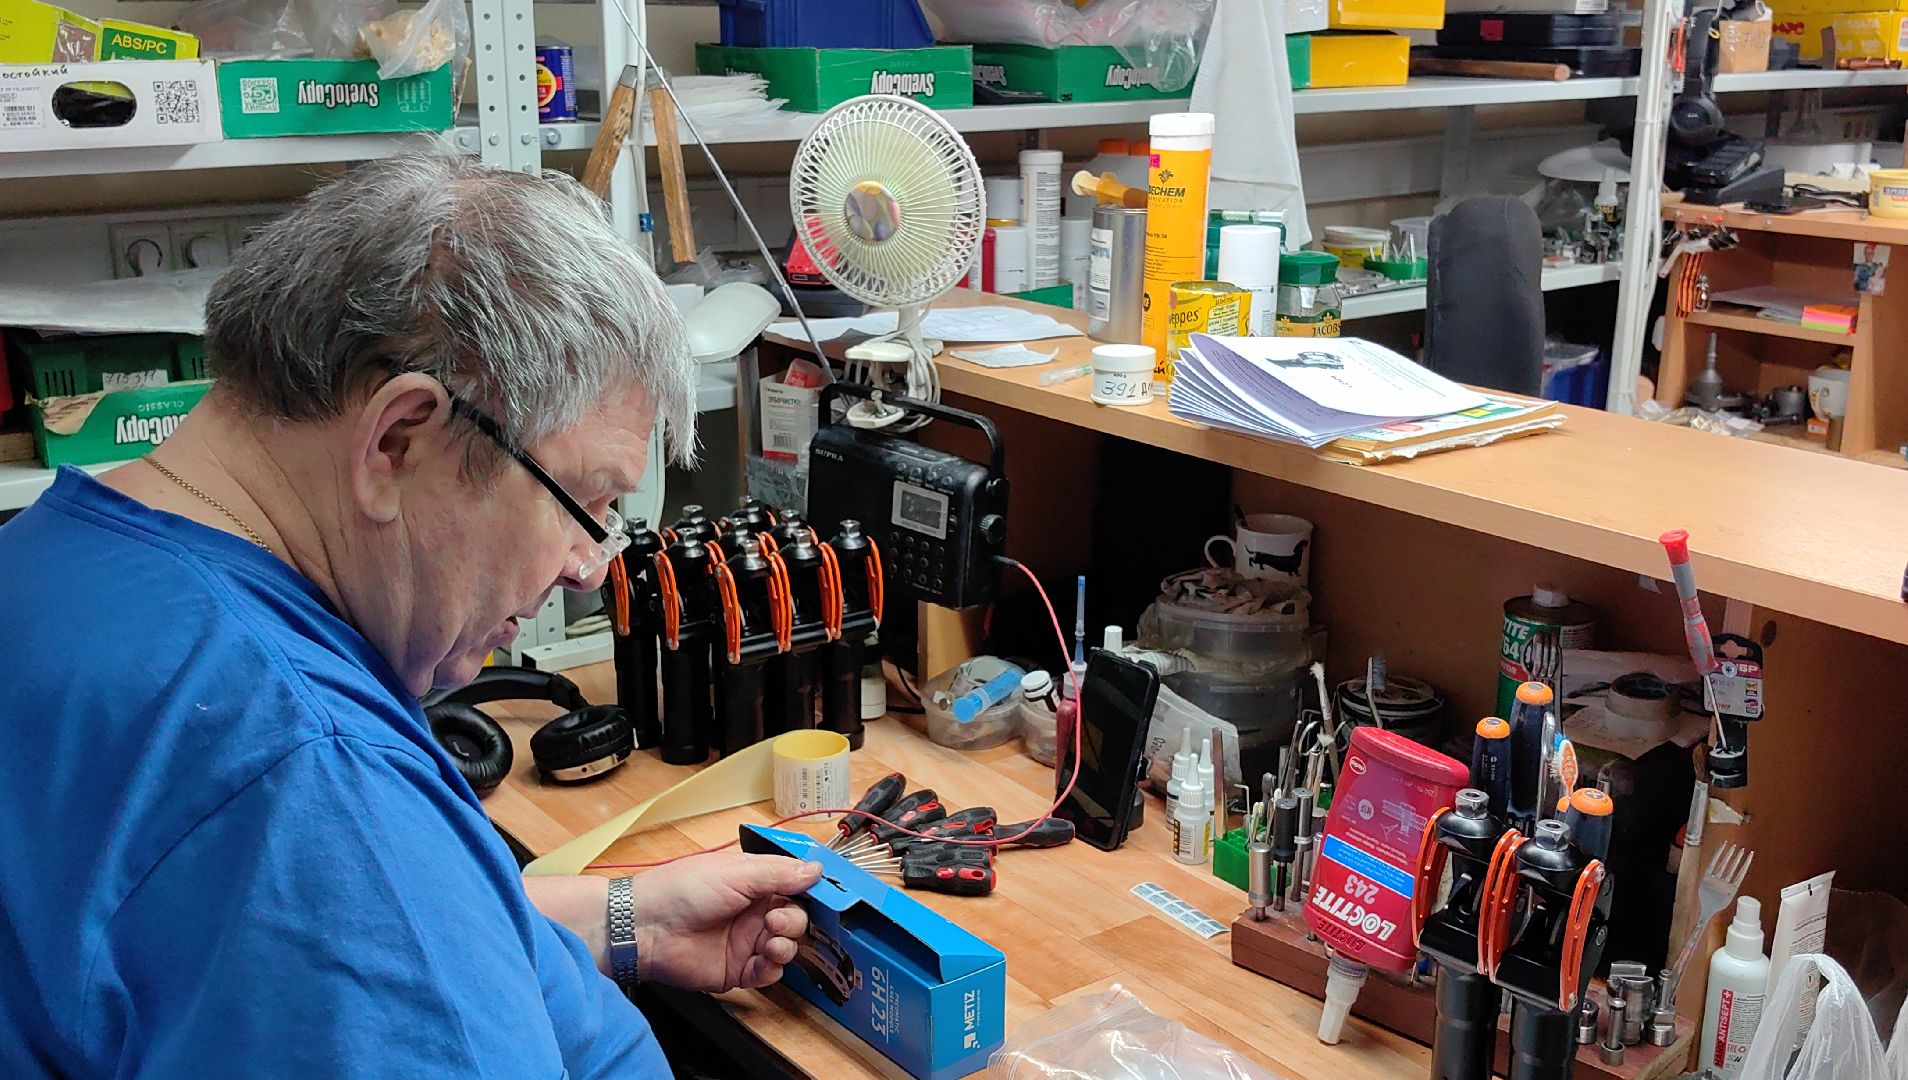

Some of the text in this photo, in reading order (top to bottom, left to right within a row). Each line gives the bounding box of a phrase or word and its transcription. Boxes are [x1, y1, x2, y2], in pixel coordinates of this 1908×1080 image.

[111, 34, 167, 54] ABS/PC
[297, 79, 379, 109] SvetoCopy
[870, 70, 935, 96] SvetoCopy
[1312, 321, 1342, 338] JACOBS
[138, 400, 185, 412] CLASSIC
[815, 448, 844, 462] SUPRA
[1344, 873, 1379, 905] 243
[1312, 884, 1397, 942] LOCTITE
[963, 990, 975, 1031] METIZ
